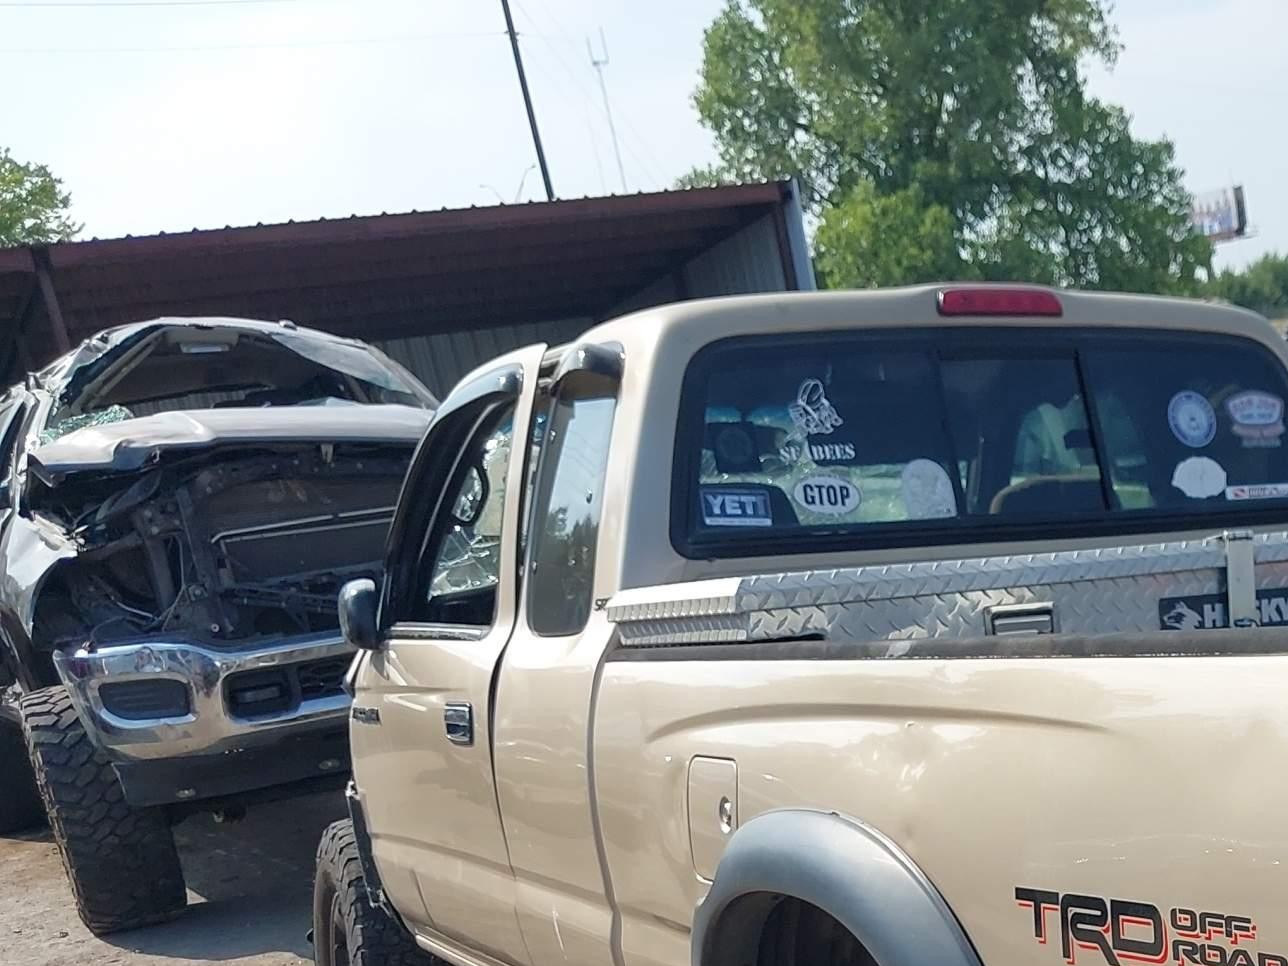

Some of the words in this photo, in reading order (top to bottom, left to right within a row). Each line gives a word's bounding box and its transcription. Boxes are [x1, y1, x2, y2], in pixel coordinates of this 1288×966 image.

[704, 494, 767, 515] YETI
[803, 484, 850, 506] GTOP
[1170, 907, 1256, 944] OFF
